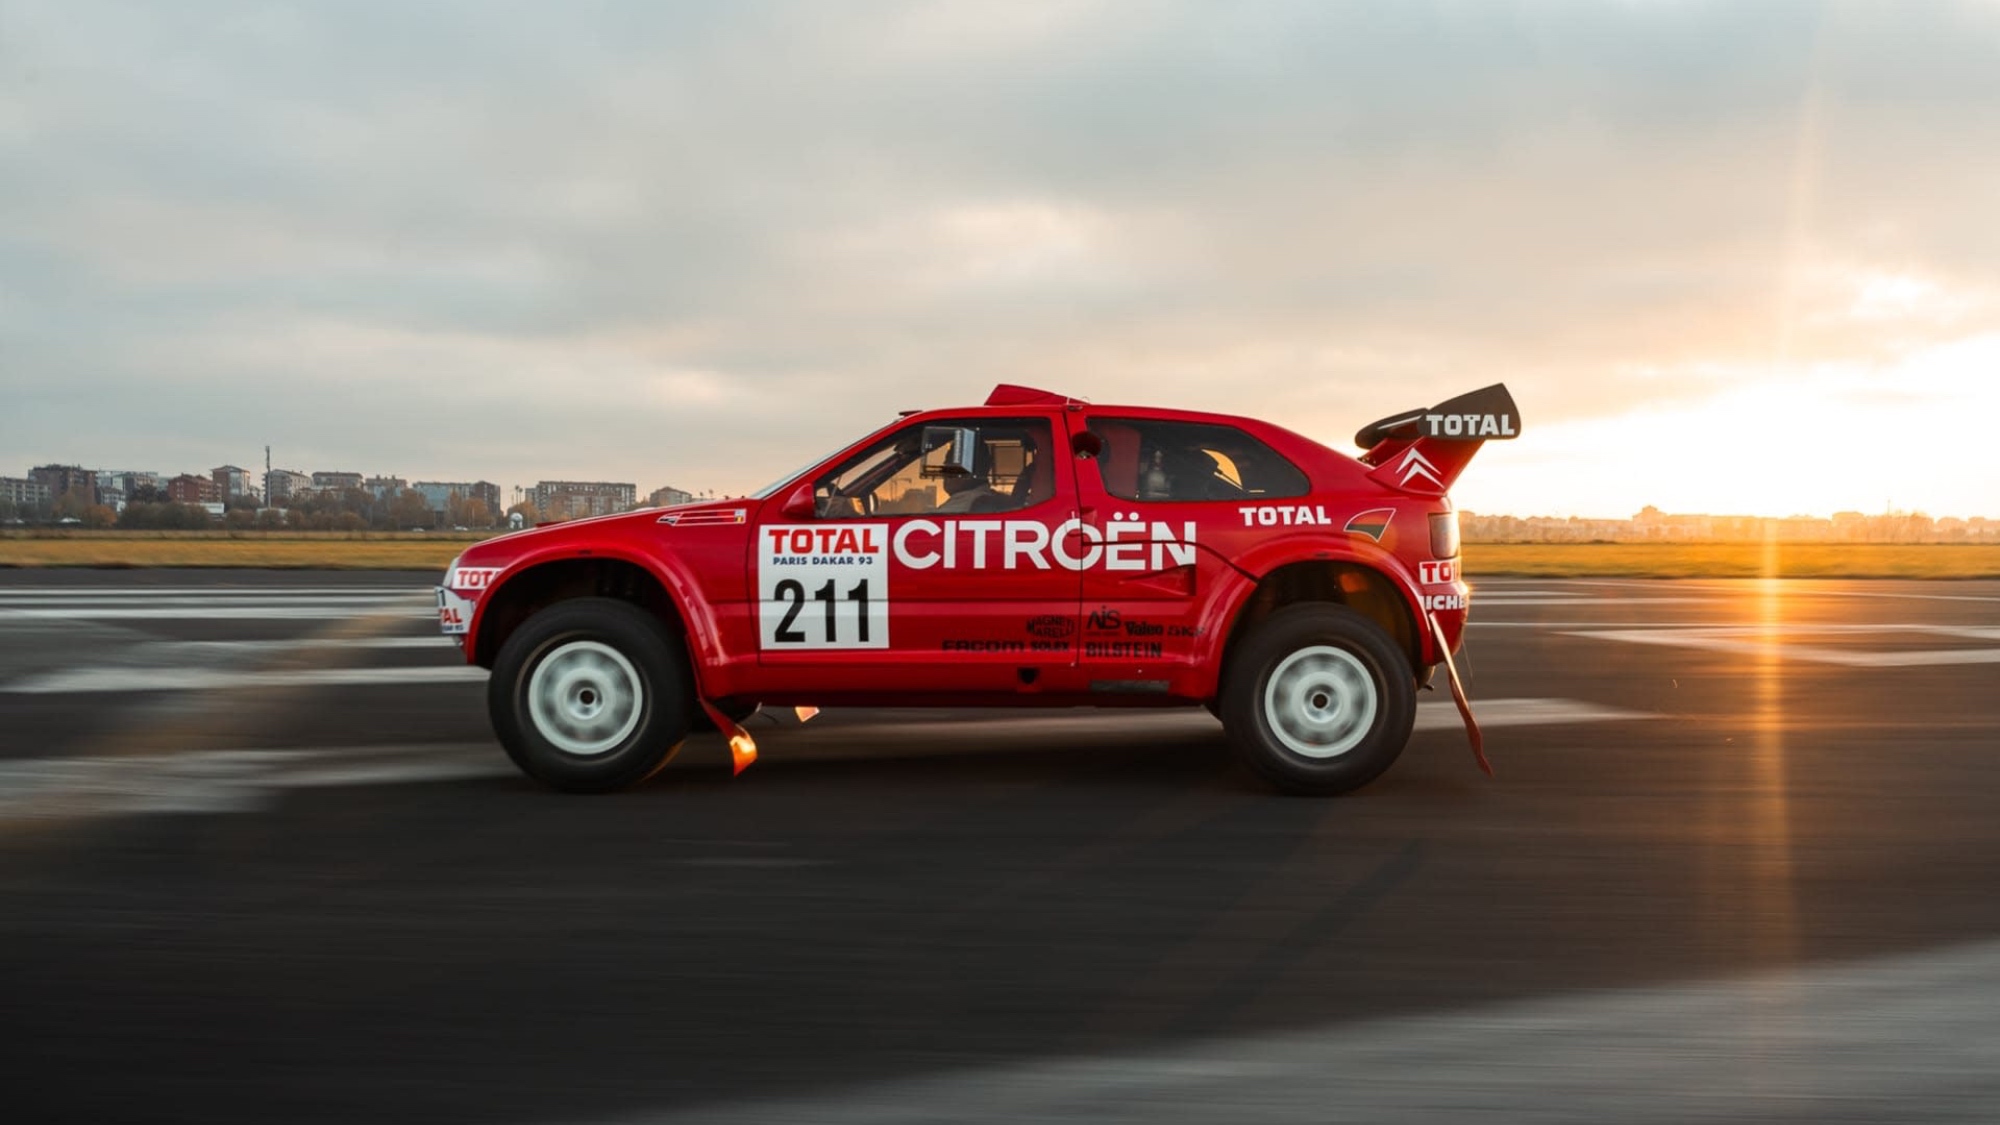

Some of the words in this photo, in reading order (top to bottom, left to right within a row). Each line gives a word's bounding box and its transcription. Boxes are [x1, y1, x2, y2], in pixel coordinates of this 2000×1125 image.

[1426, 414, 1515, 436] TOTAL
[1239, 506, 1331, 526] TOTAL
[768, 528, 880, 554] TOTAL
[893, 511, 1197, 571] CITROËN
[772, 556, 807, 565] PARIS
[812, 556, 854, 565] DAKAR
[858, 556, 873, 565] 93
[774, 579, 869, 642] 211
[1085, 641, 1162, 658] BILSTEIN
